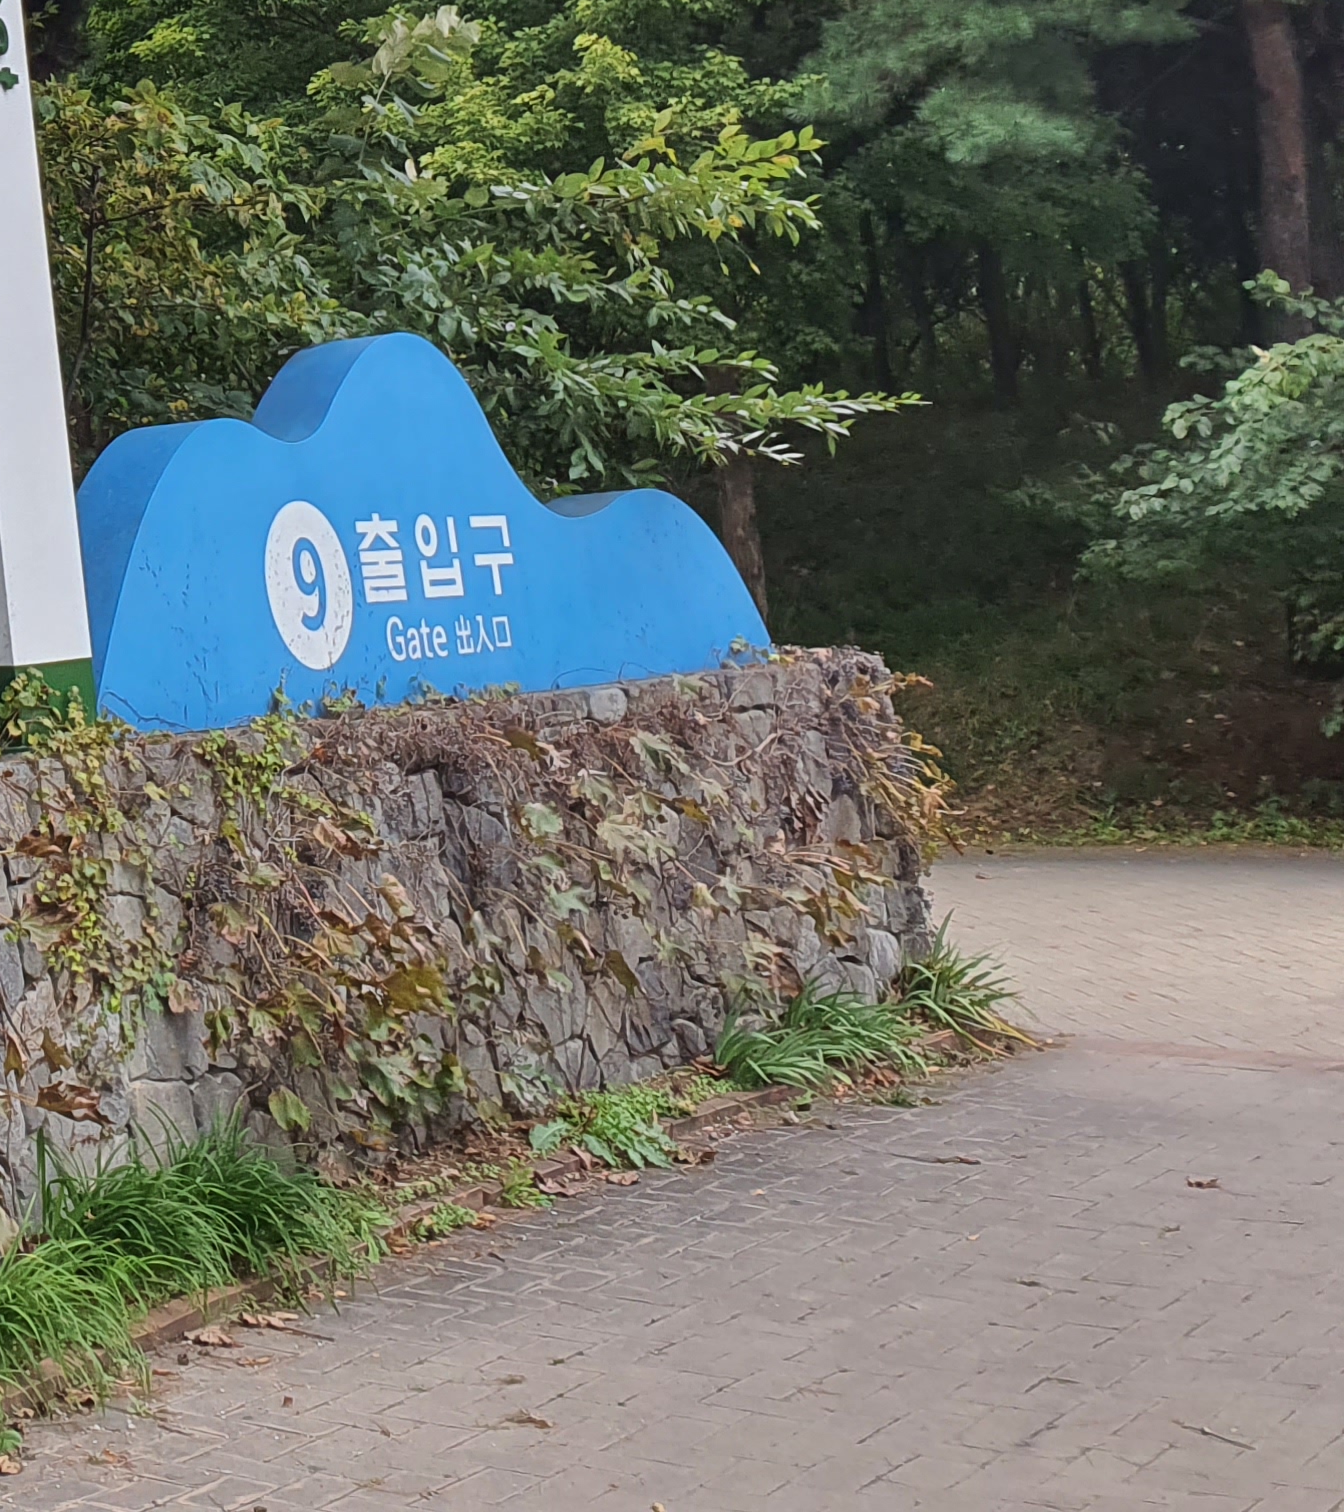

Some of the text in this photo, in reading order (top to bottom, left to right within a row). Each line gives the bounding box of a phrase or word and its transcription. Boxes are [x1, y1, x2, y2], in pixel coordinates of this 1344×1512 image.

[292, 512, 514, 632] 9 출입구
[385, 614, 512, 662] Gate 出入口
